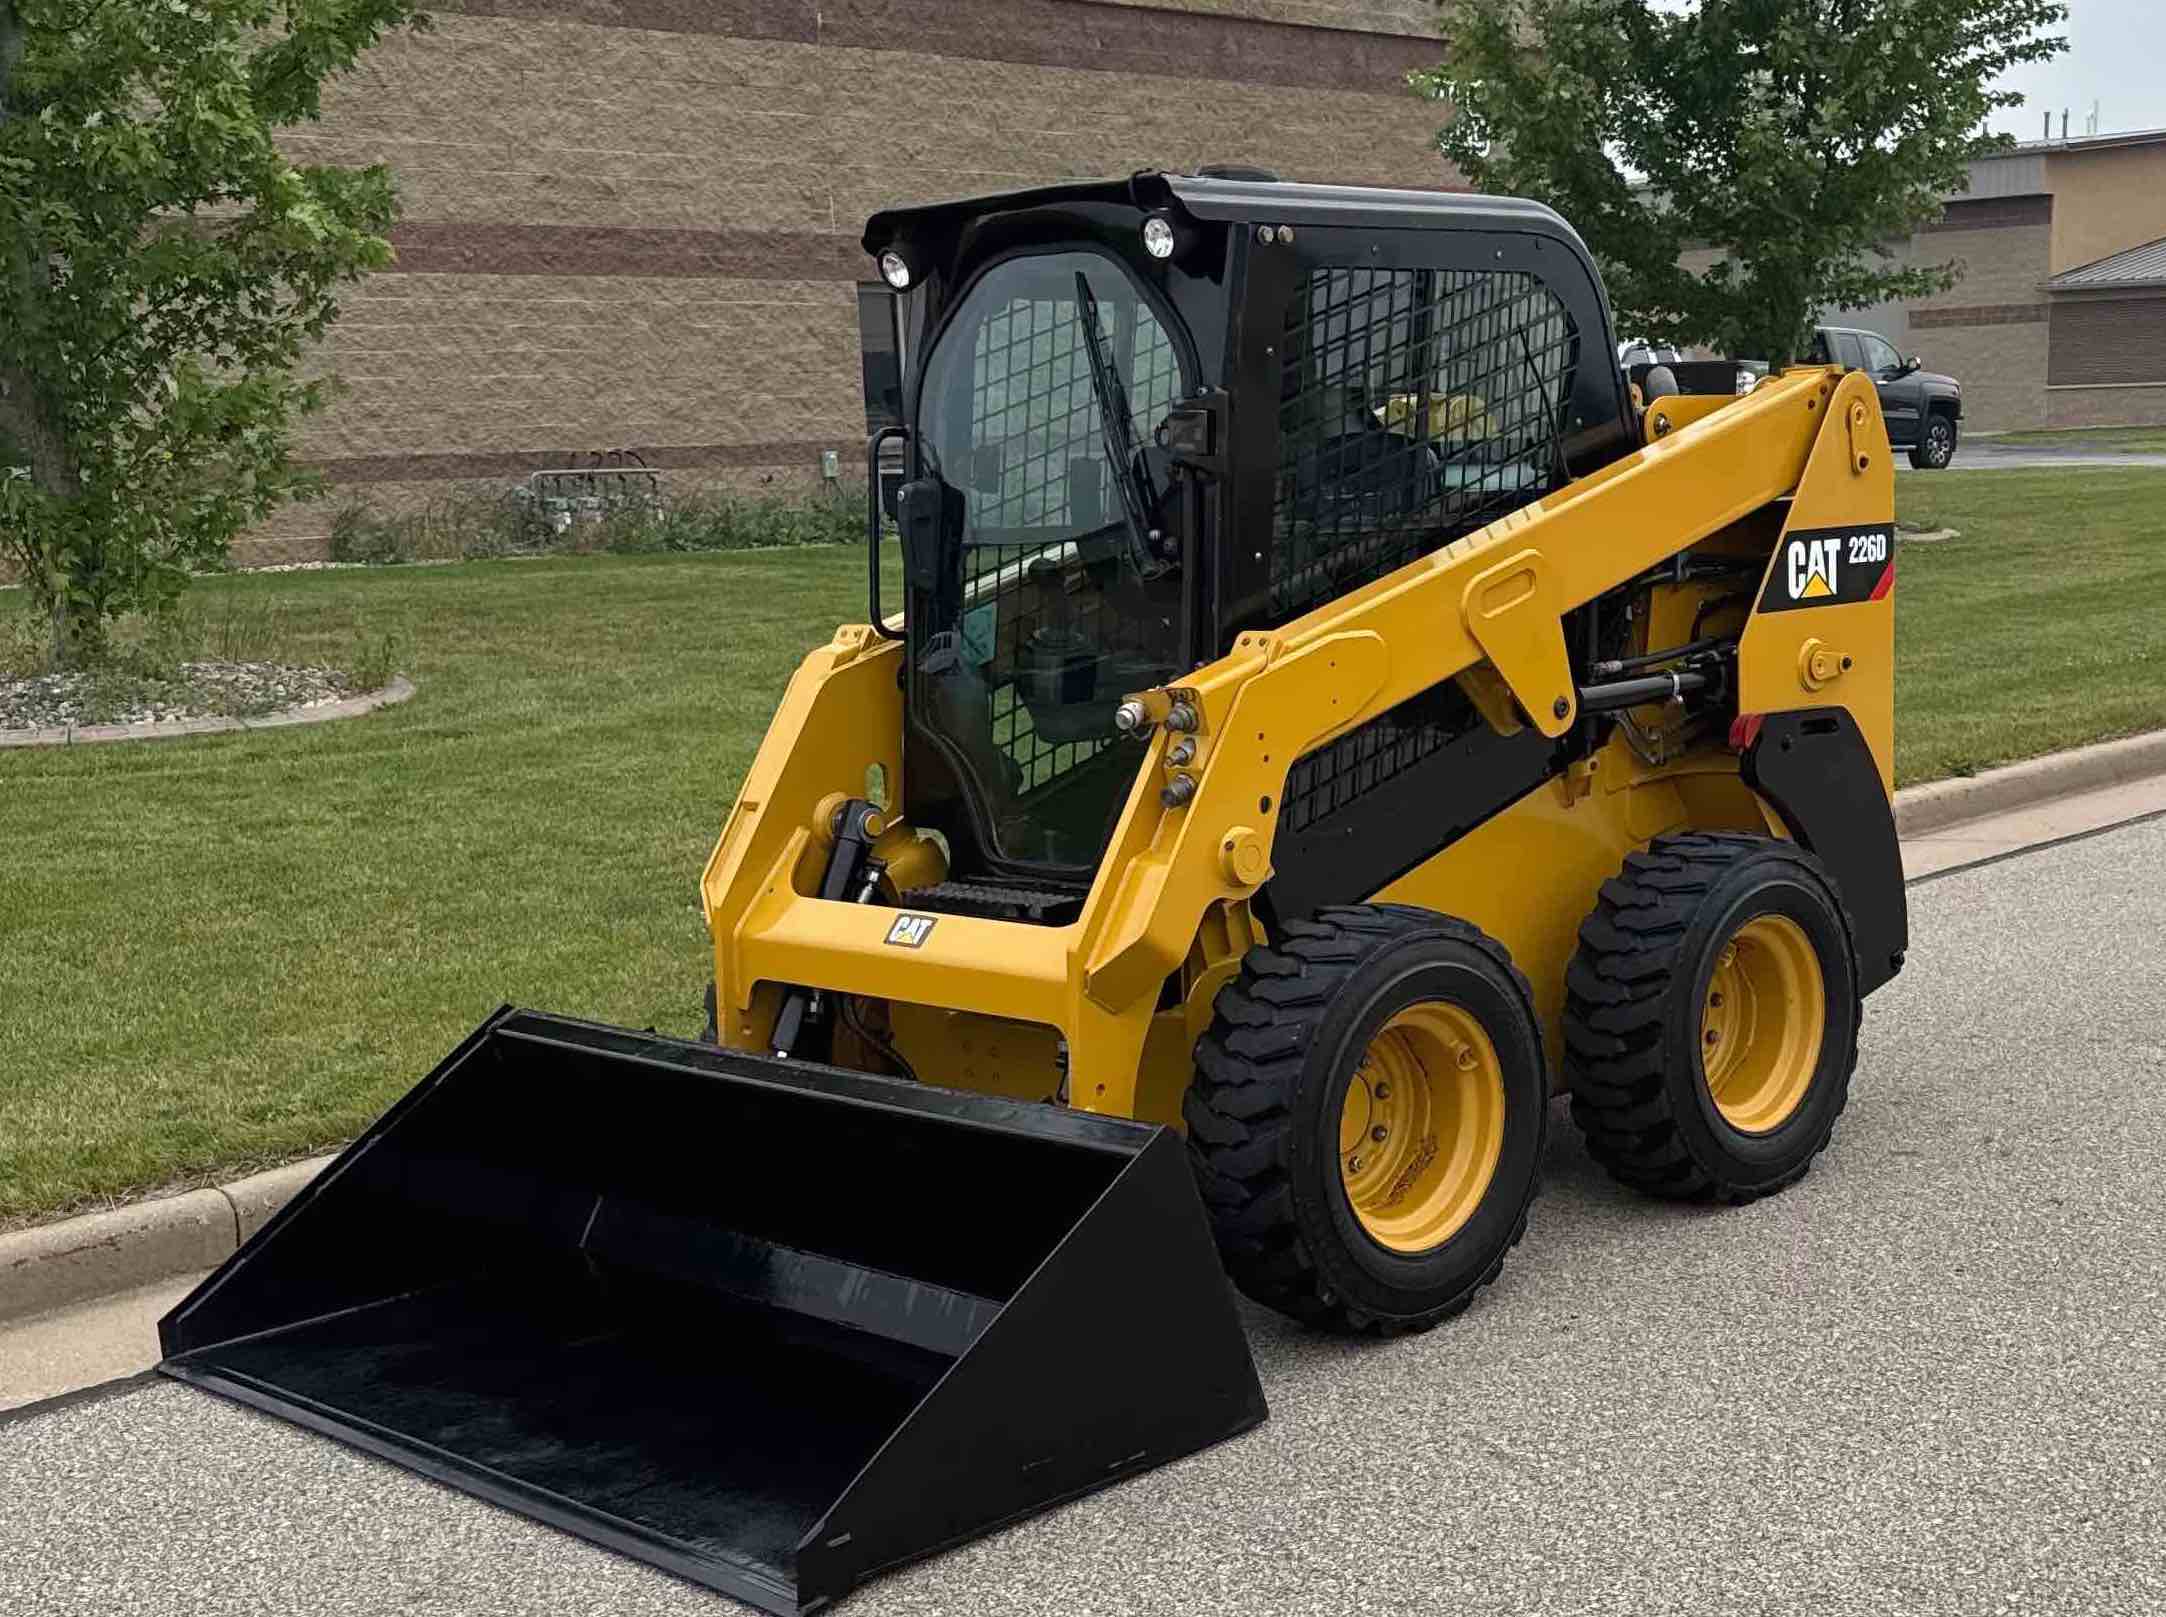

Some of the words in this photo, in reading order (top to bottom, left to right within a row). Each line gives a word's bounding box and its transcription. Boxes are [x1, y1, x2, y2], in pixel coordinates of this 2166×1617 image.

[1787, 538, 1841, 600] CAT
[1848, 534, 1887, 564] 226D
[888, 915, 934, 945] CAT
